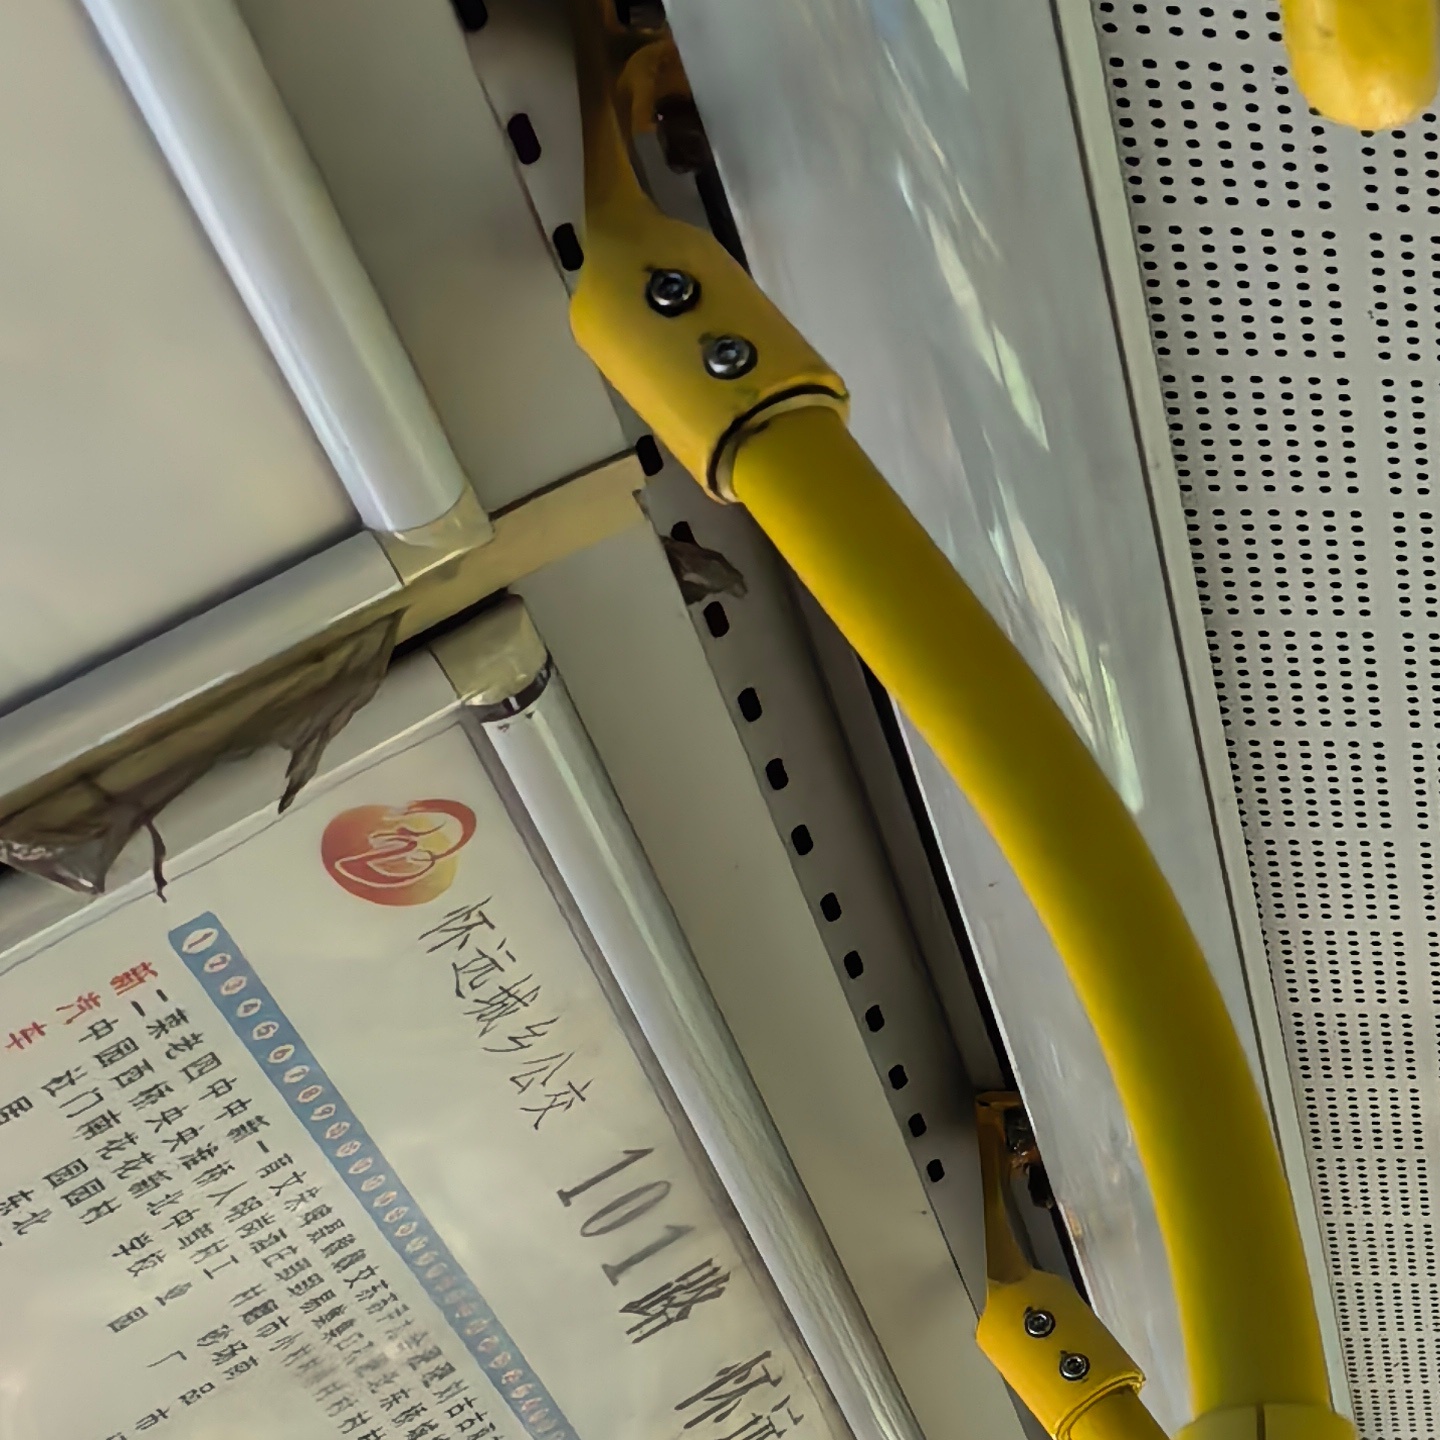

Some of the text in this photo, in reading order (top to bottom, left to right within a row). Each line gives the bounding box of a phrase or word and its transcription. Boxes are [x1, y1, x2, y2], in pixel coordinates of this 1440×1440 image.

[78, 989, 169, 1043] 二中
[58, 1032, 204, 1118] 老西门
[418, 896, 593, 1130] 怀远城乡公交
[556, 1148, 731, 1344] 101路
[0, 1098, 252, 1246] 中央花园北
